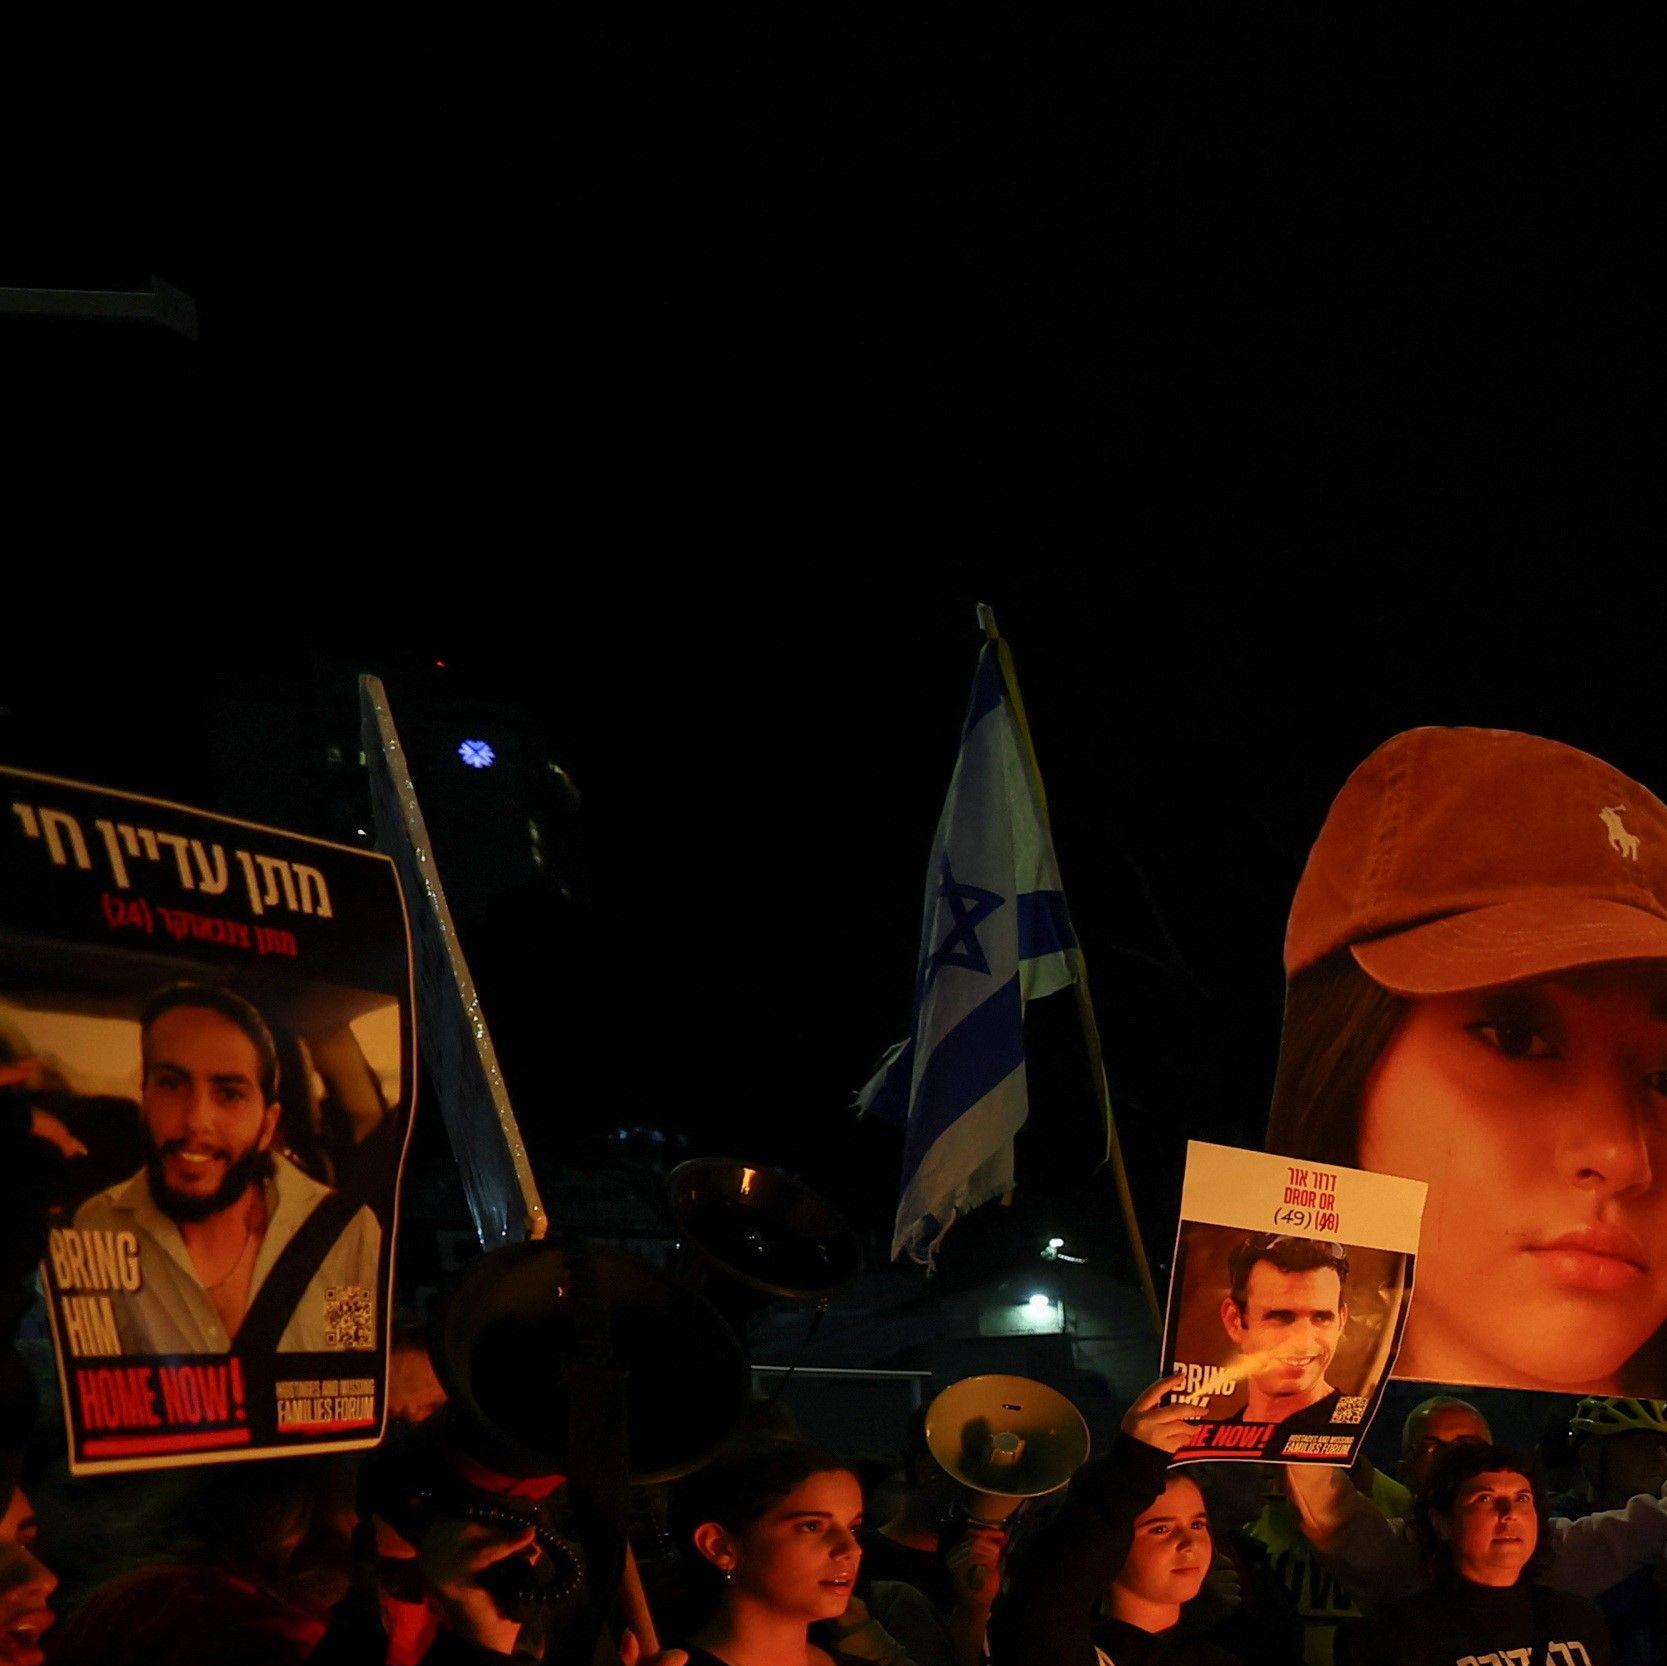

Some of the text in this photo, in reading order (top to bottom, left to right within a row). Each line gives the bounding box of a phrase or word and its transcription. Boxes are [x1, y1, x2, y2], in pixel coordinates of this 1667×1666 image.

[11, 802, 334, 920] מתן עדיין חי
[1287, 1167, 1337, 1192] דרור אור
[1283, 1187, 1335, 1211] DROR OR
[1274, 1207, 1312, 1229] (49)
[50, 1228, 143, 1292] BRING
[61, 1296, 122, 1358] HIM
[75, 1355, 249, 1429] HOME NOW!
[277, 1396, 374, 1426] FAMILIES FORUM
[1214, 1424, 1277, 1449] NOW!
[1283, 1441, 1352, 1456] FAMILIES FORUM
